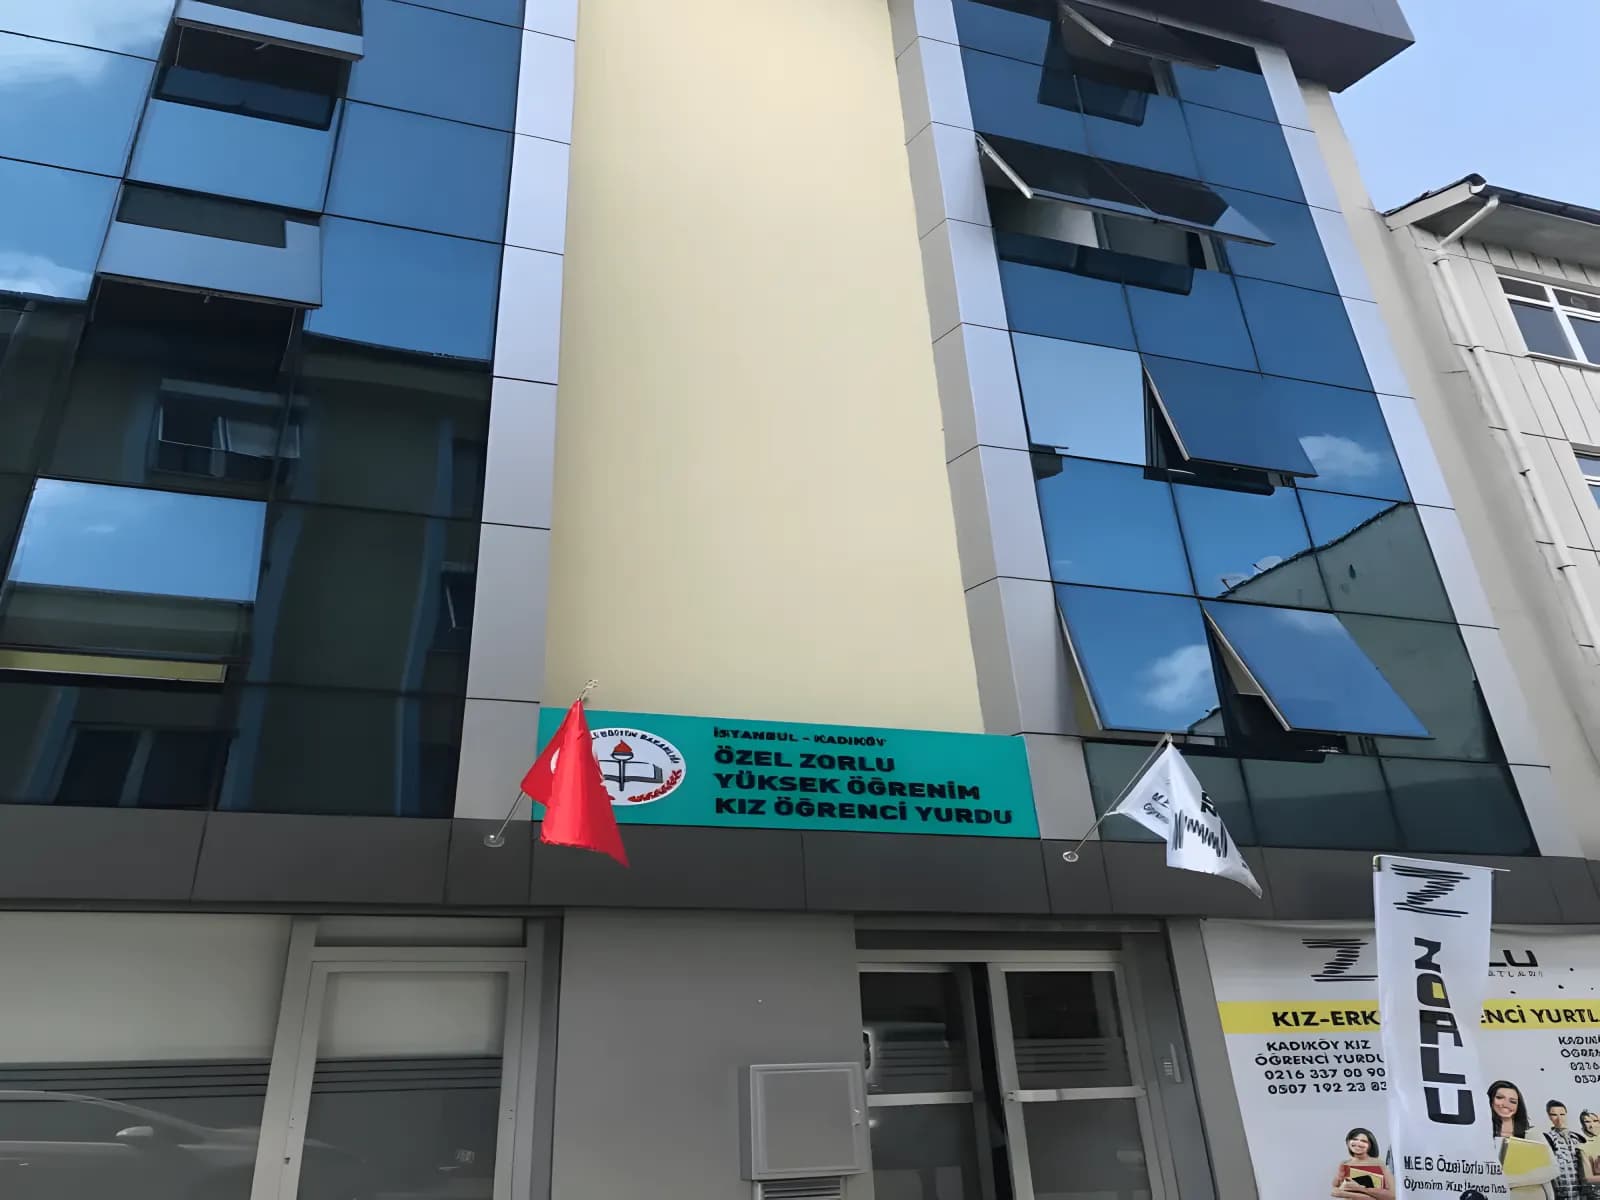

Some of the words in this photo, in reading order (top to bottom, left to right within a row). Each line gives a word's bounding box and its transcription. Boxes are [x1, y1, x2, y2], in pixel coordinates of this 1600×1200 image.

[714, 745, 793, 768] ÖZEL
[799, 753, 895, 773] ZORLU
[713, 770, 841, 794] YÜKSEK
[847, 775, 980, 800] ÖĞRENİM
[715, 797, 767, 816] KIZ
[774, 796, 908, 821] ÖĞRENCİ
[915, 806, 1013, 825] YURDU
[1271, 1010, 1381, 1027] KIZ-ERK
[1530, 1008, 1600, 1024] YURTL
[1414, 936, 1476, 1126] ZORLU
[1266, 1038, 1340, 1052] KADIKÖY
[1344, 1039, 1372, 1050] KIZ
[1264, 1070, 1305, 1080] 0216
[1310, 1069, 1338, 1079] 337
[1367, 1067, 1387, 1077] 90
[1267, 1084, 1307, 1094] 0507
[1313, 1083, 1343, 1093] 192
